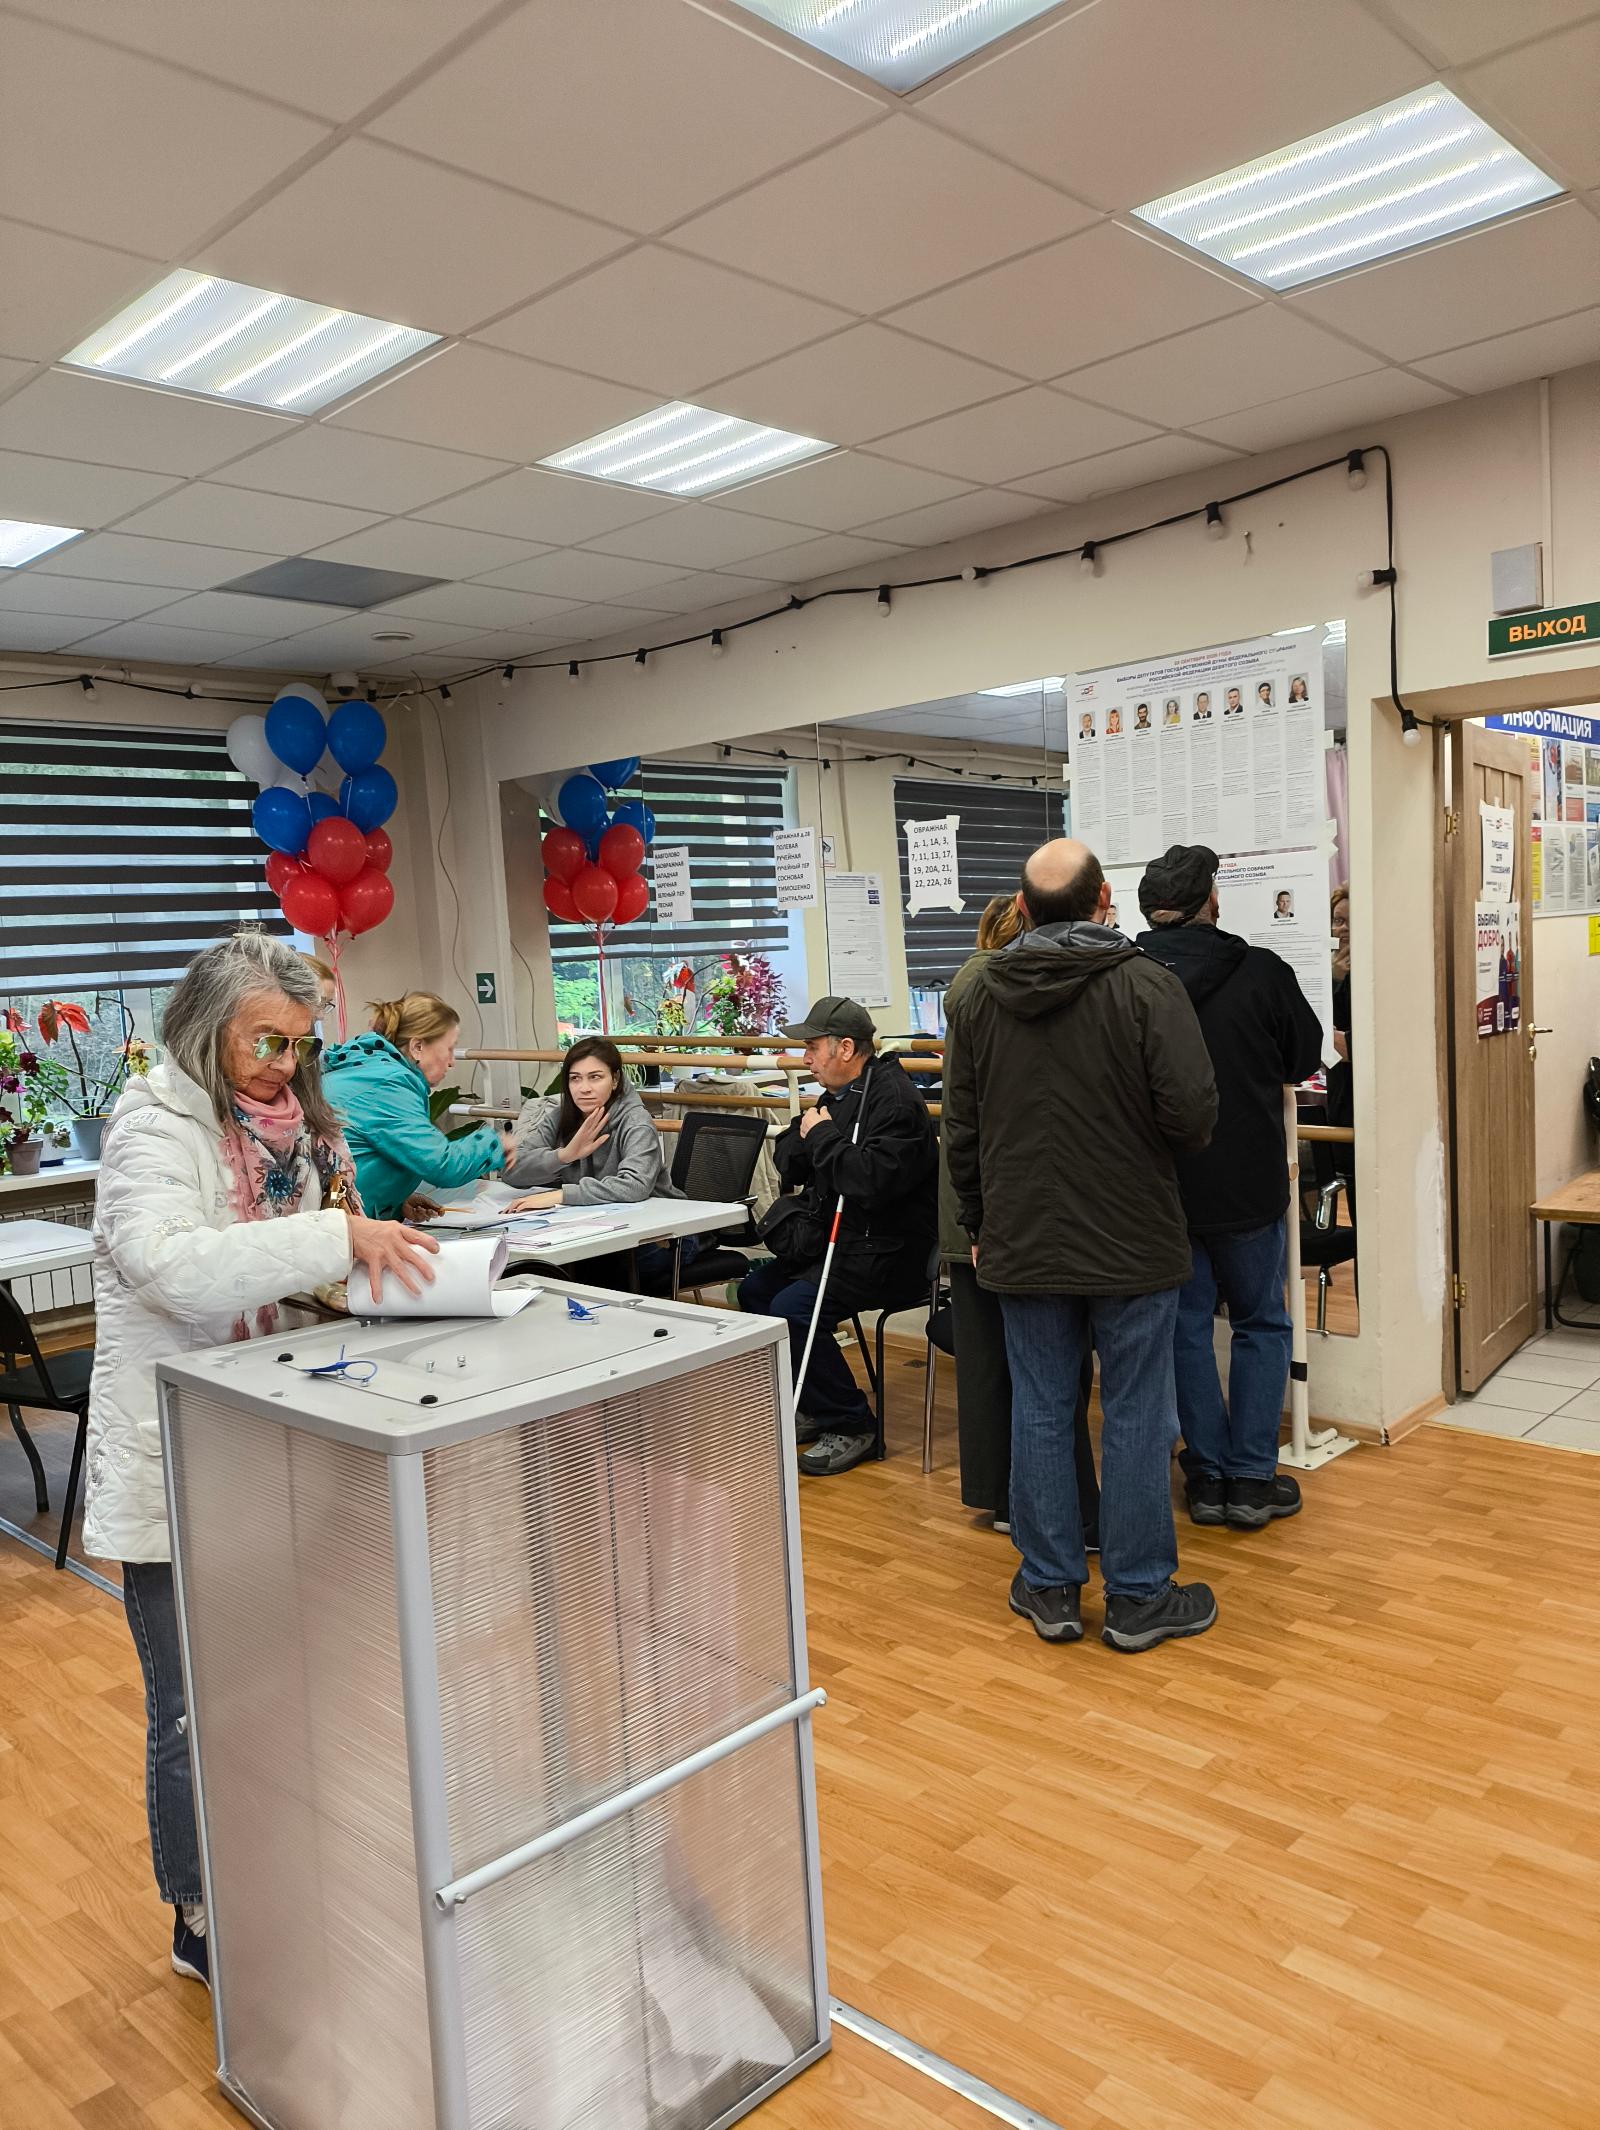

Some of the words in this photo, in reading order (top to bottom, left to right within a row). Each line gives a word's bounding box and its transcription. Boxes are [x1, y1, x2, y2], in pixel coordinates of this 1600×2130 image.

[1509, 615, 1586, 643] ВЫХОД
[1137, 669, 1163, 679] ДЕПУТАТОВ
[1164, 660, 1211, 673] ГОСУДАРСТВЕННОЙ
[1212, 657, 1226, 665] ДУМЫ
[1228, 650, 1267, 661] ФЕДЕРАЛЬНОГО
[1149, 672, 1180, 682] РОССИЙСКОЙ
[1182, 667, 1211, 676] ФЕДЕРАЦИИ
[1212, 662, 1237, 671] ДЕВЯТОГО
[1503, 710, 1592, 739] ИНФОРМАЦИЯ
[930, 838, 941, 846] 1А,
[943, 837, 949, 845] 3,
[777, 853, 801, 861] РУЧЕЙНАЯ
[919, 853, 929, 861] 11,
[931, 851, 941, 859] 13,
[943, 850, 953, 858] 17,
[655, 861, 684, 869] ЗАОВРАЖНАЯ
[777, 863, 800, 871] РУЧЕЙНЫЙ
[914, 867, 923, 875] 19,
[925, 865, 940, 873] 20А,
[942, 864, 952, 872] 21,
[778, 884, 810, 892] ТИМОШЕНКО
[915, 880, 925, 888] 22,
[927, 878, 941, 886] 22А,
[779, 894, 813, 902] ЦЕНТРАЛЬНАЯ
[1477, 910, 1500, 926] ВЫБИРАЙ
[1477, 929, 1500, 951] ДОБРО
